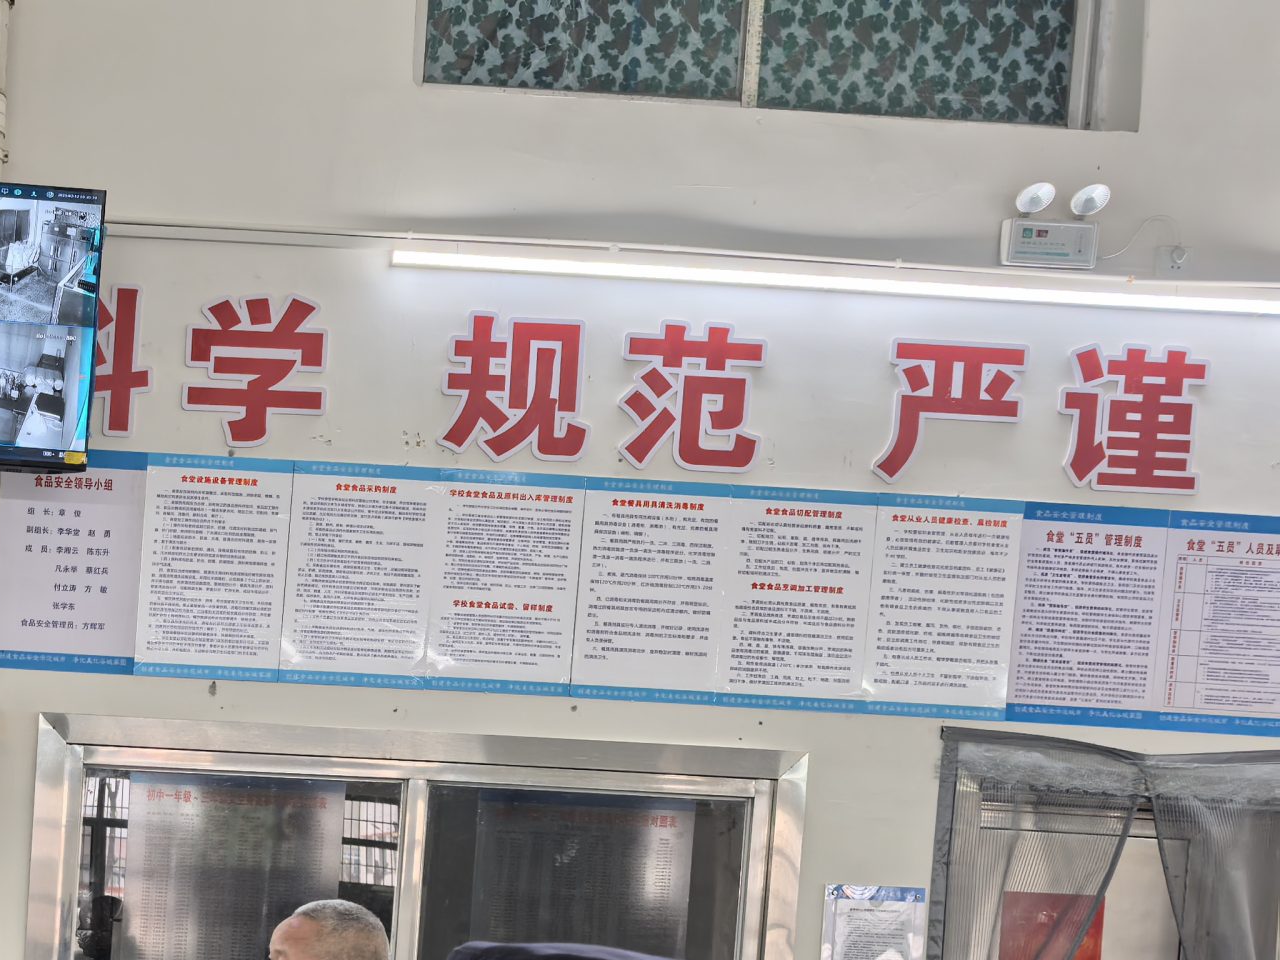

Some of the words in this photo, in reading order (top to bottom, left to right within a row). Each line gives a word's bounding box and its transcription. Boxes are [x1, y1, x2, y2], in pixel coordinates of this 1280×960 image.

[439, 309, 767, 473] 规范
[872, 336, 1211, 494] 严谨
[34, 474, 113, 491] 食品安全领导小组
[181, 474, 258, 487] 食堂设施设备管理制度
[335, 483, 398, 494] 食堂食品采购制度
[449, 489, 574, 504] 学校食堂食品及原料出入库管理制度
[611, 498, 705, 511] 食堂餐具用具清洗消毒制度
[765, 507, 843, 519] 食堂食品切配管理制度
[891, 514, 1008, 528] 食堂从业人员健康检查、晨检制度
[751, 582, 844, 595] 食堂食品烹调加工管理制度
